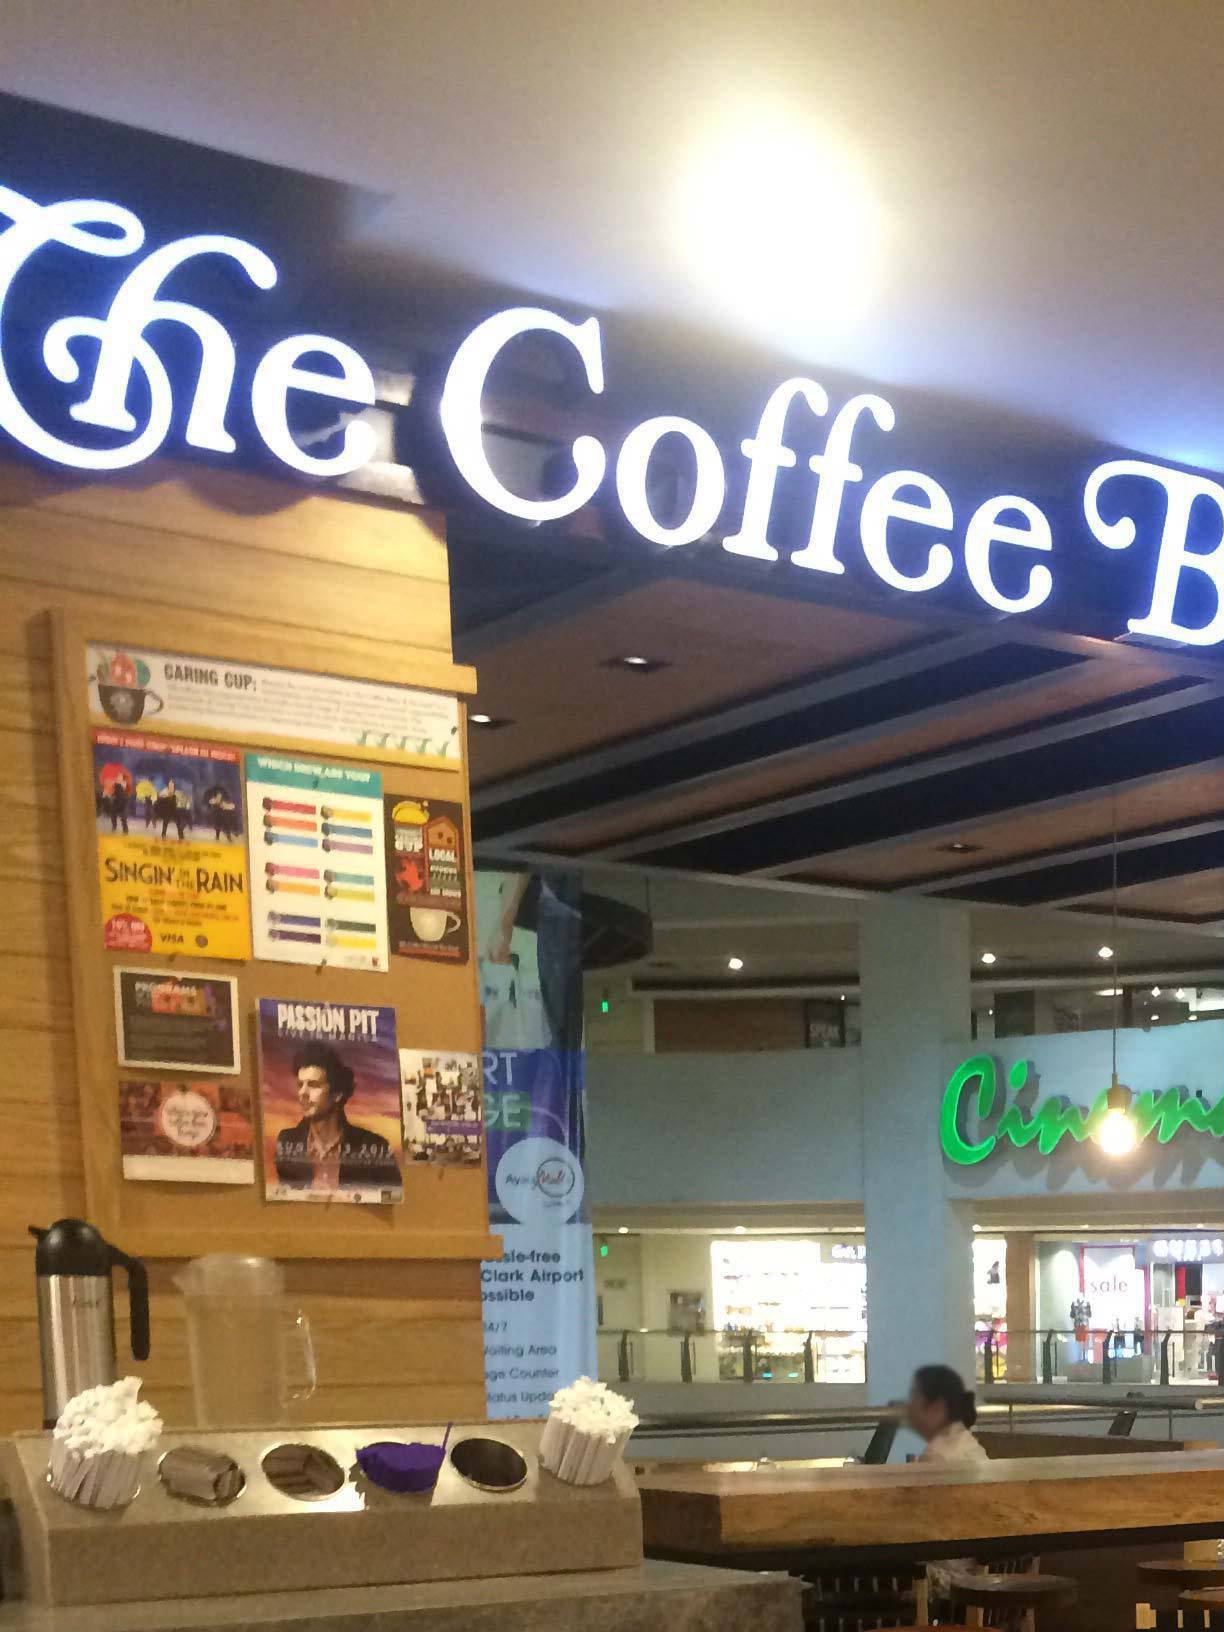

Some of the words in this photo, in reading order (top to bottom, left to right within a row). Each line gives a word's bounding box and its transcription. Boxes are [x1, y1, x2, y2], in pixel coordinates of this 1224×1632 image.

[0, 182, 377, 478] The
[440, 308, 1053, 613] Coffee
[164, 663, 219, 686] CARING
[224, 671, 257, 692] CUP:
[196, 868, 243, 893] RAIN
[160, 933, 184, 945] VISA
[277, 1004, 345, 1032] PASSION
[349, 1008, 379, 1034] PIT
[481, 1269, 524, 1283] Clark
[530, 1269, 584, 1285] Airport
[1090, 1275, 1128, 1294] sale
[509, 1368, 560, 1380] Counter
